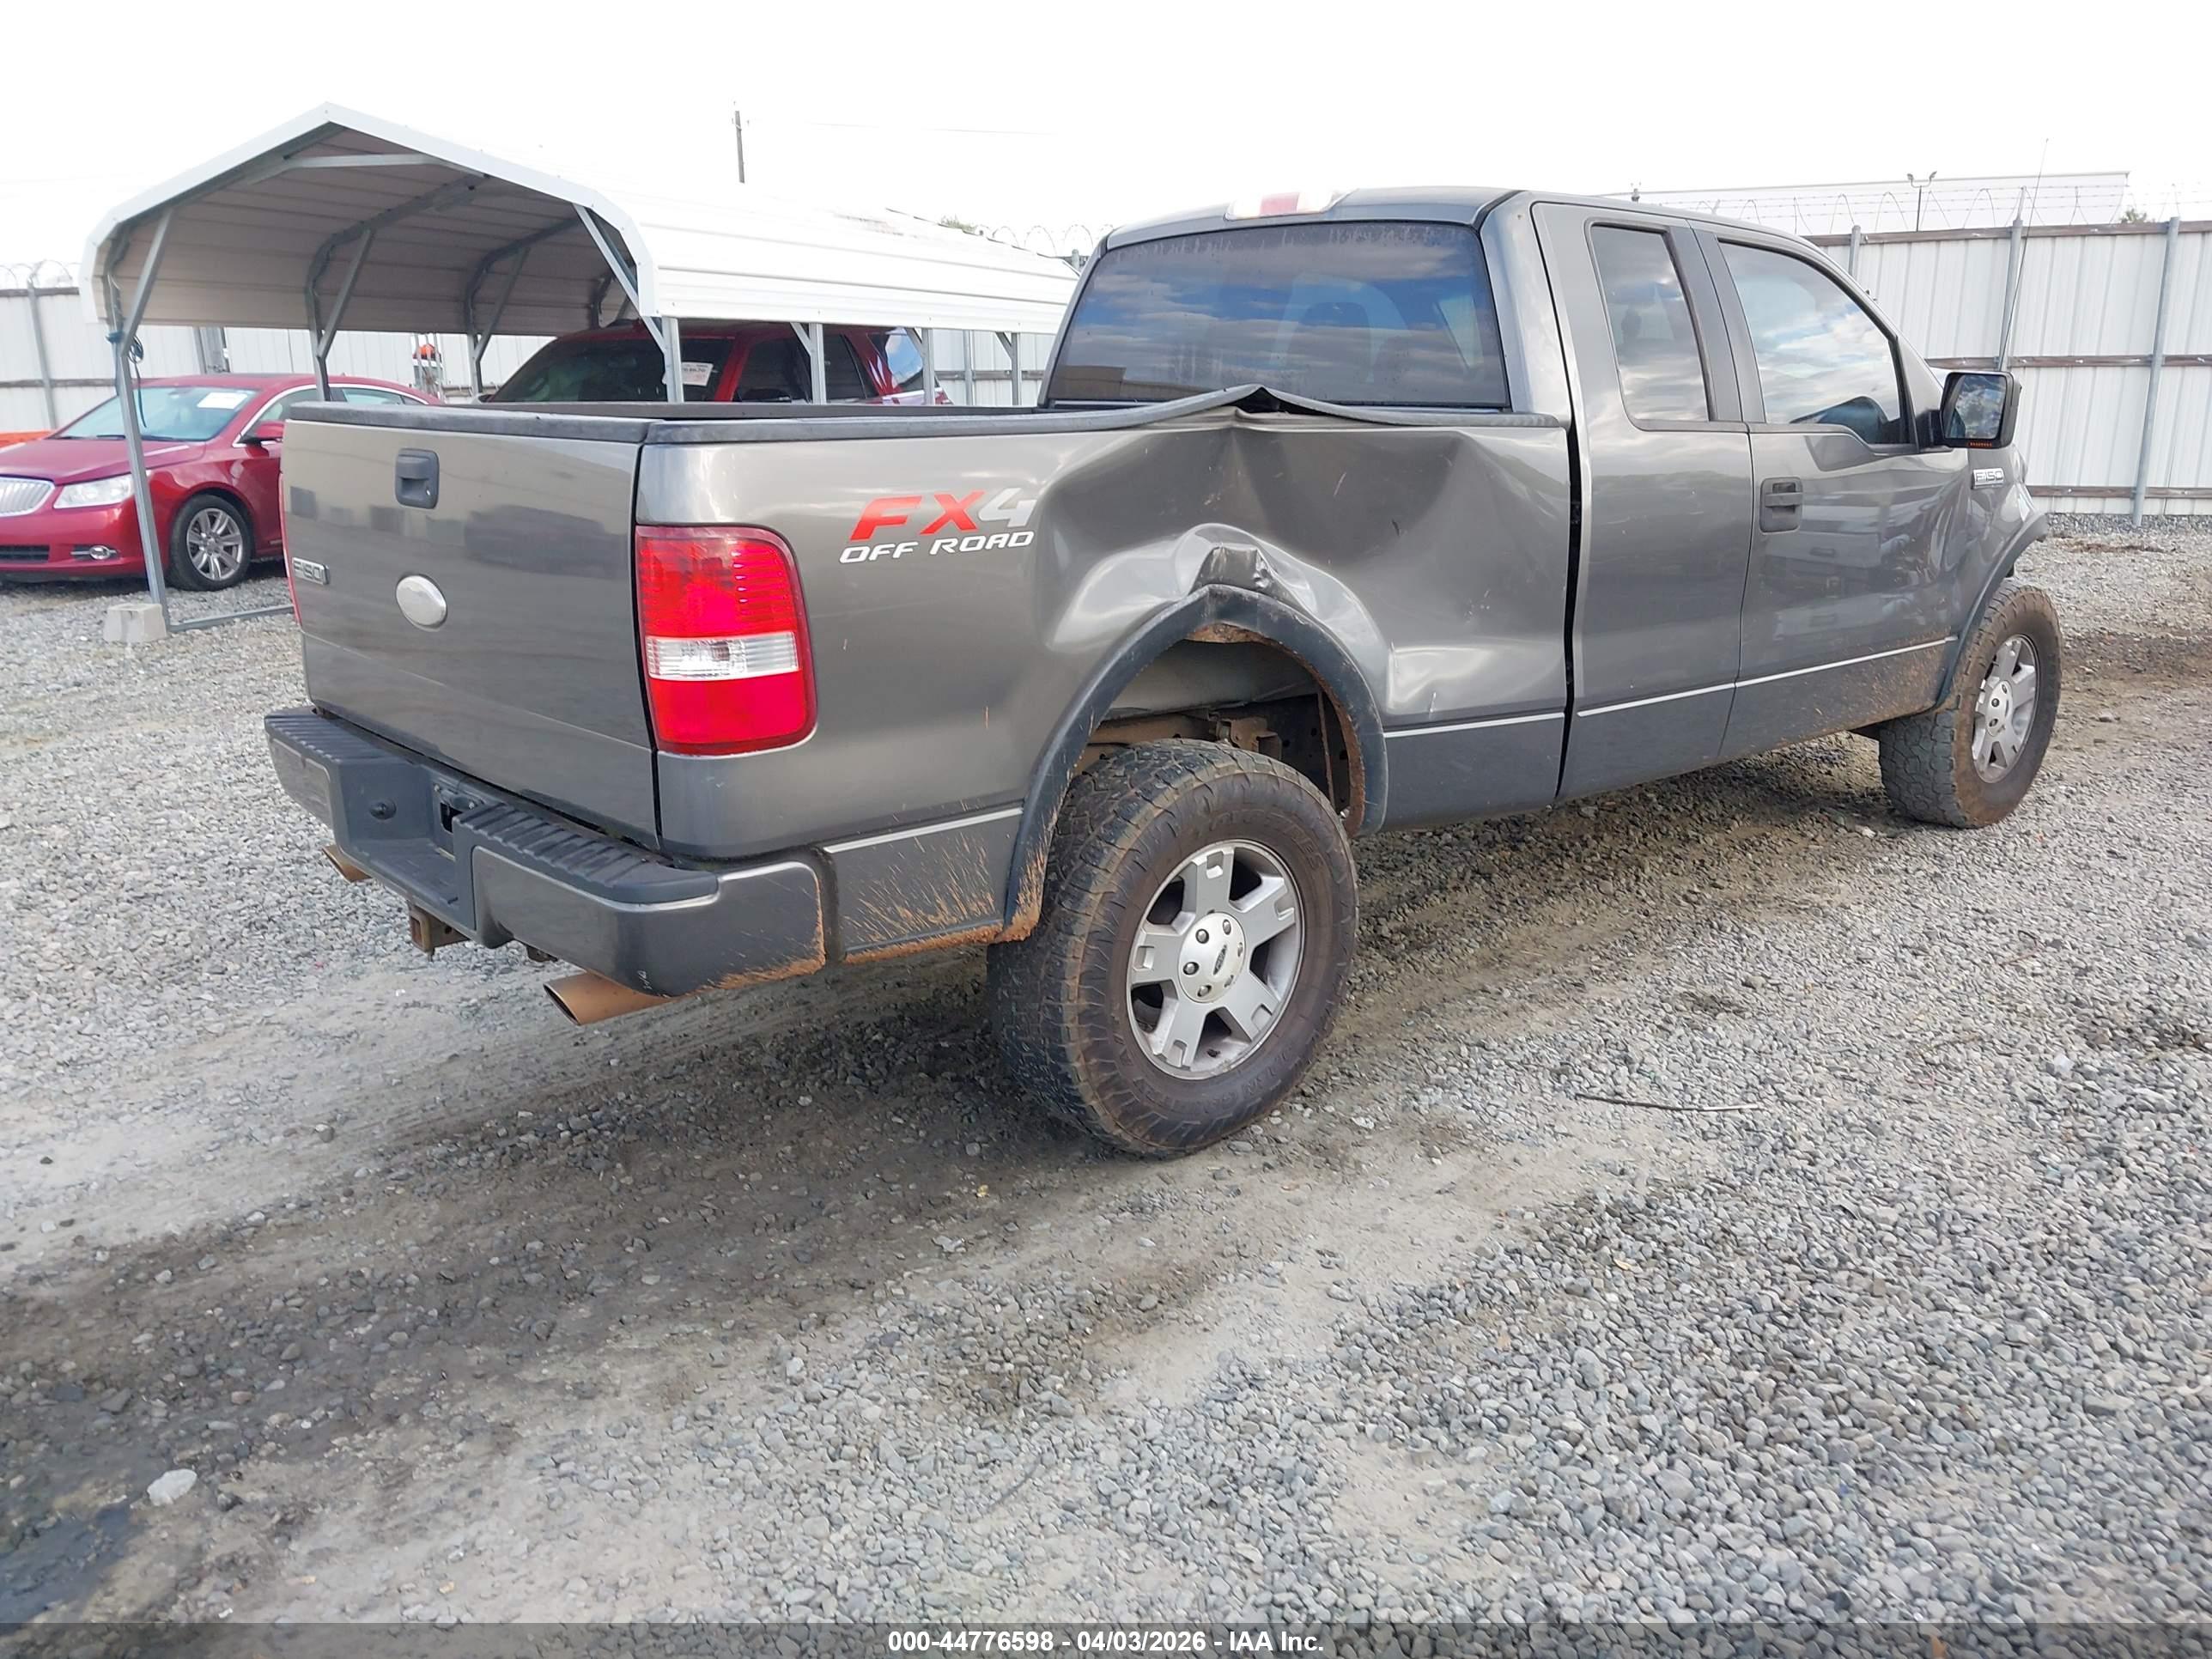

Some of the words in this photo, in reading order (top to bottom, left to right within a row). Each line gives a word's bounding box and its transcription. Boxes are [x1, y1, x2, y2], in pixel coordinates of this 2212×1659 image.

[849, 488, 1037, 542] FX4
[839, 541, 919, 563] OFF
[930, 531, 1035, 555] ROAD
